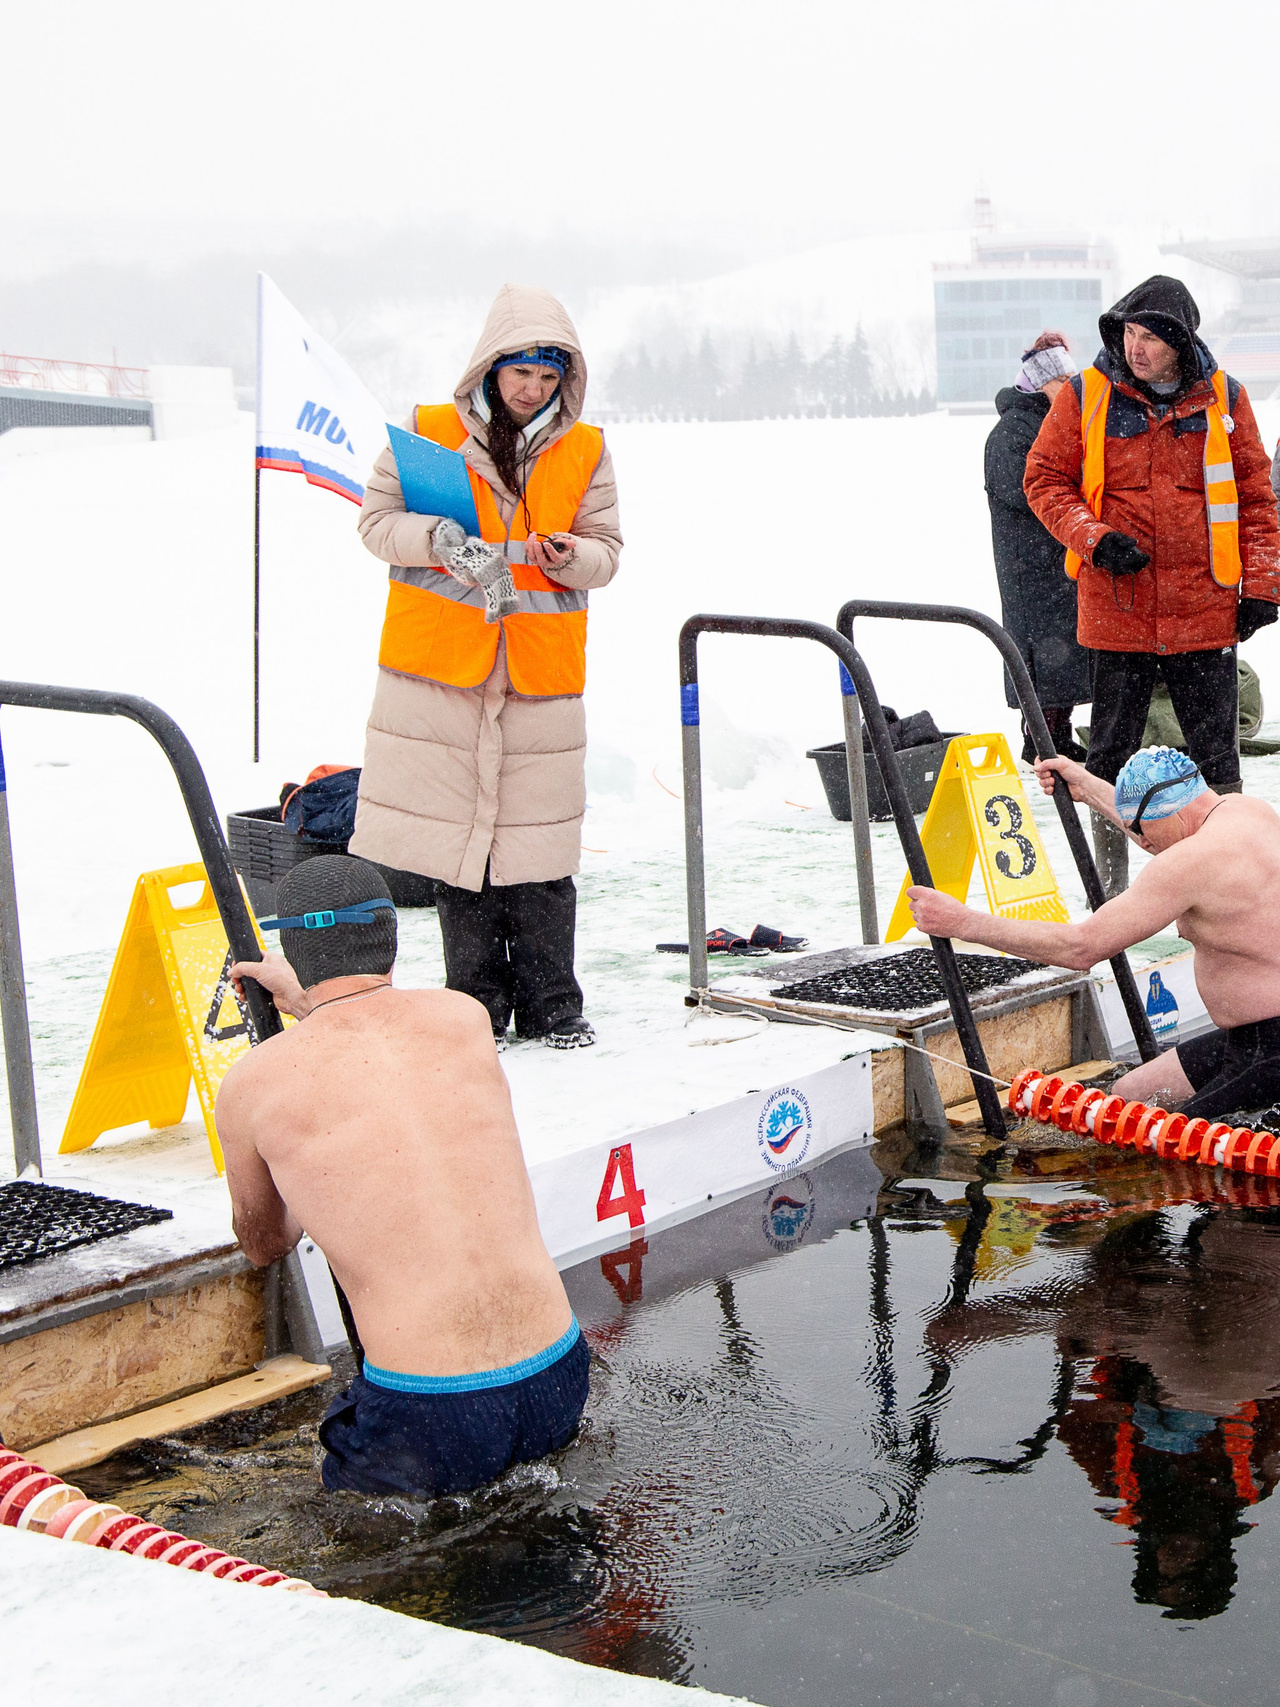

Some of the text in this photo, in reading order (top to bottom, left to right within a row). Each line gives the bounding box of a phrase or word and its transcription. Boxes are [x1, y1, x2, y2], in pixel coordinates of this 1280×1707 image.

[985, 795, 1036, 879] 3
[758, 1087, 812, 1146] ВСЕРОССИЙСКАЯ ФЕДЕРАЦИЯ
[596, 1143, 646, 1228] 4
[761, 1133, 811, 1172] ЗИМНЕГО ПЛАВАНИЯ
